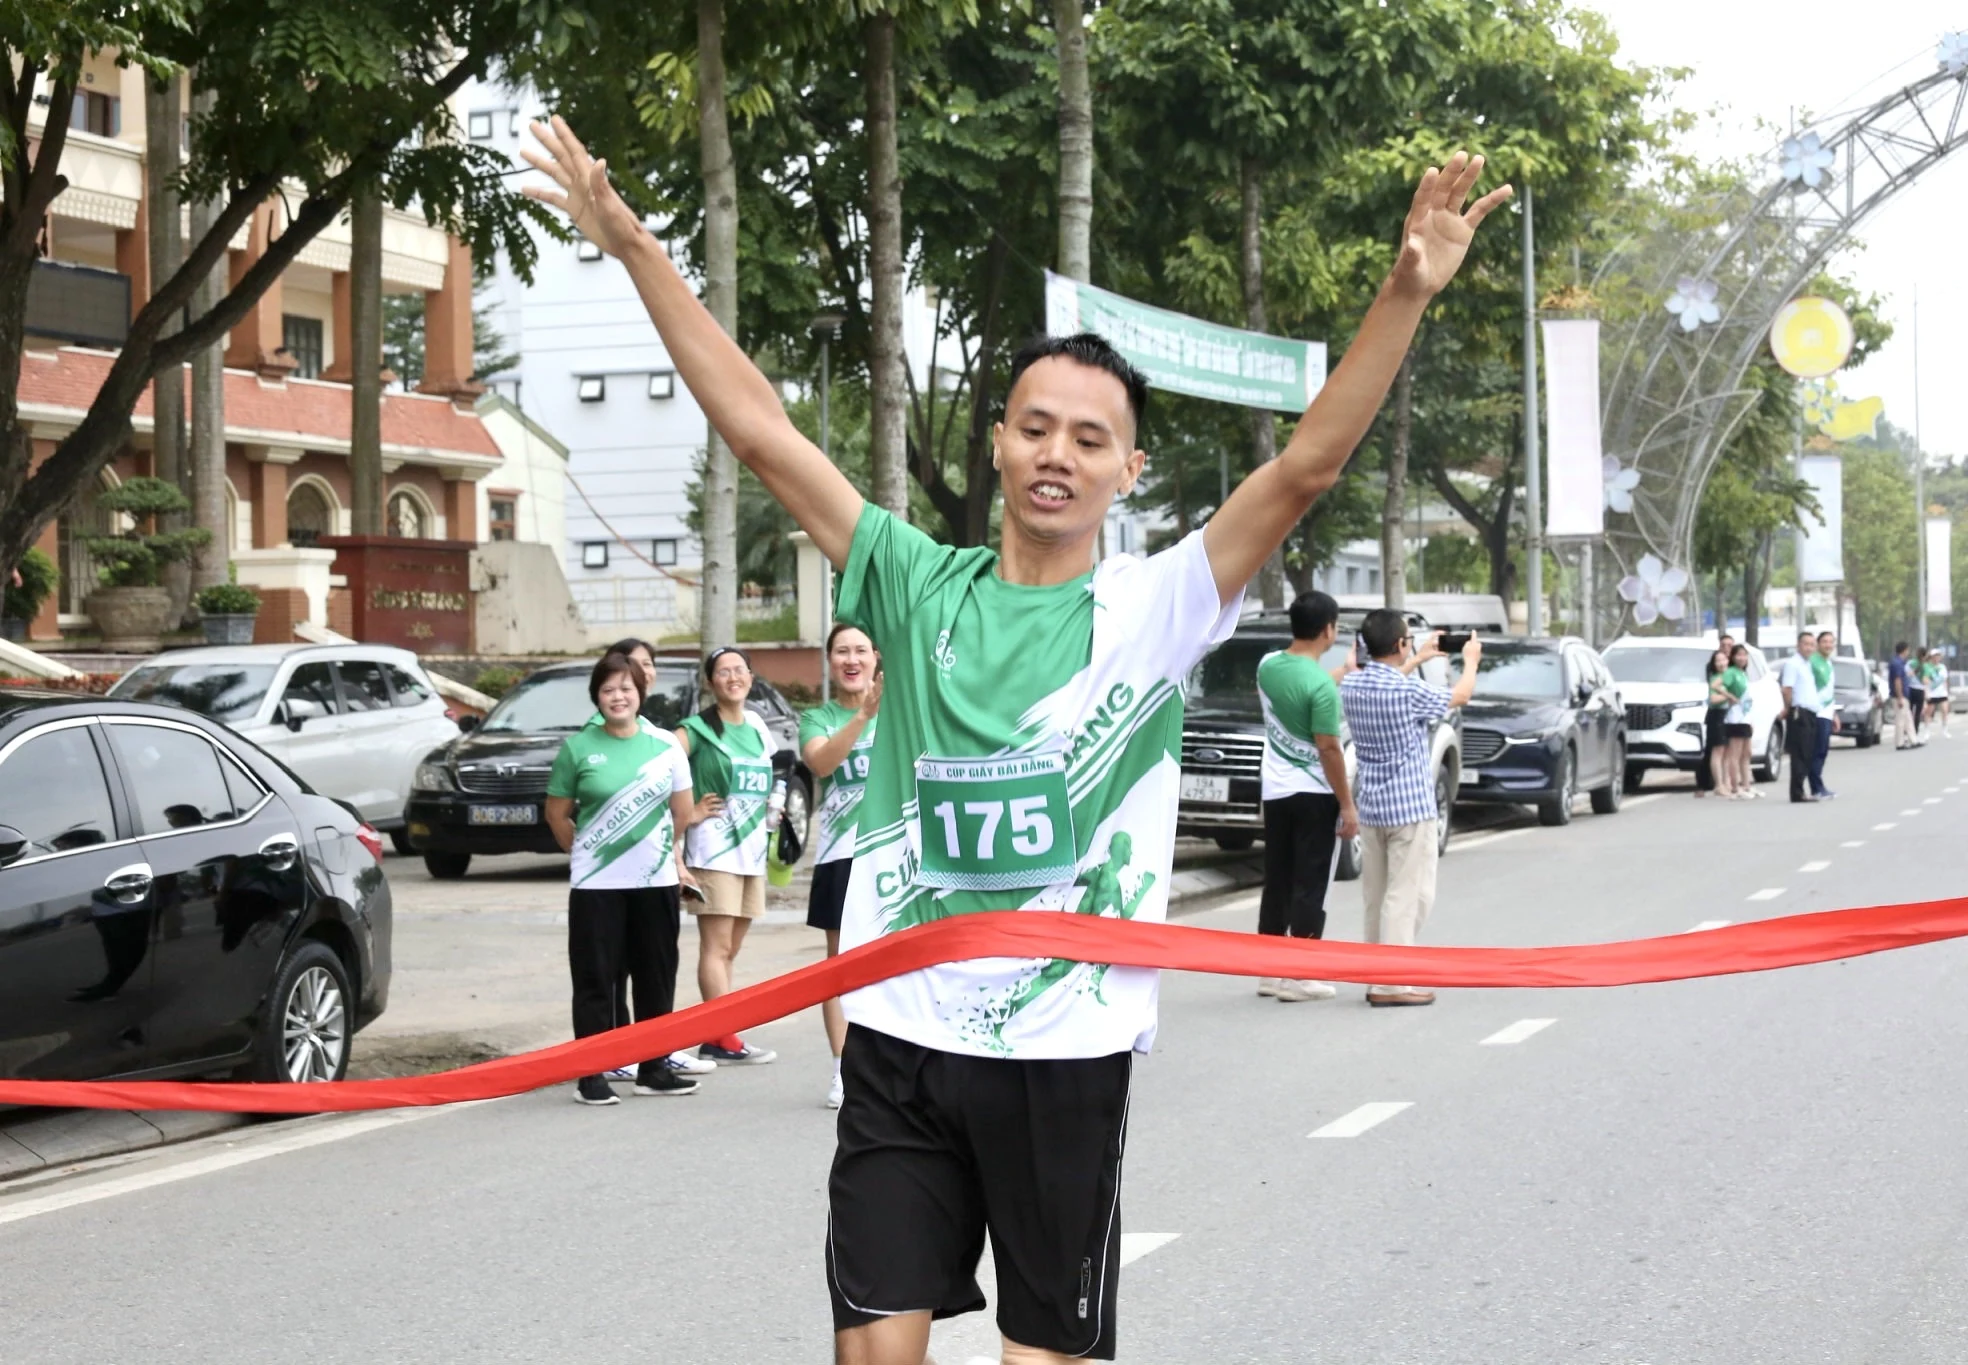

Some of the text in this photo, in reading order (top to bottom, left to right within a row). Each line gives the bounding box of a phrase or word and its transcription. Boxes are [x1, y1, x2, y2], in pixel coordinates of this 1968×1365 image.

[737, 771, 768, 792] 120
[583, 828, 605, 850] CÚP
[607, 802, 633, 830] GIẤY
[934, 795, 1053, 859] 175
